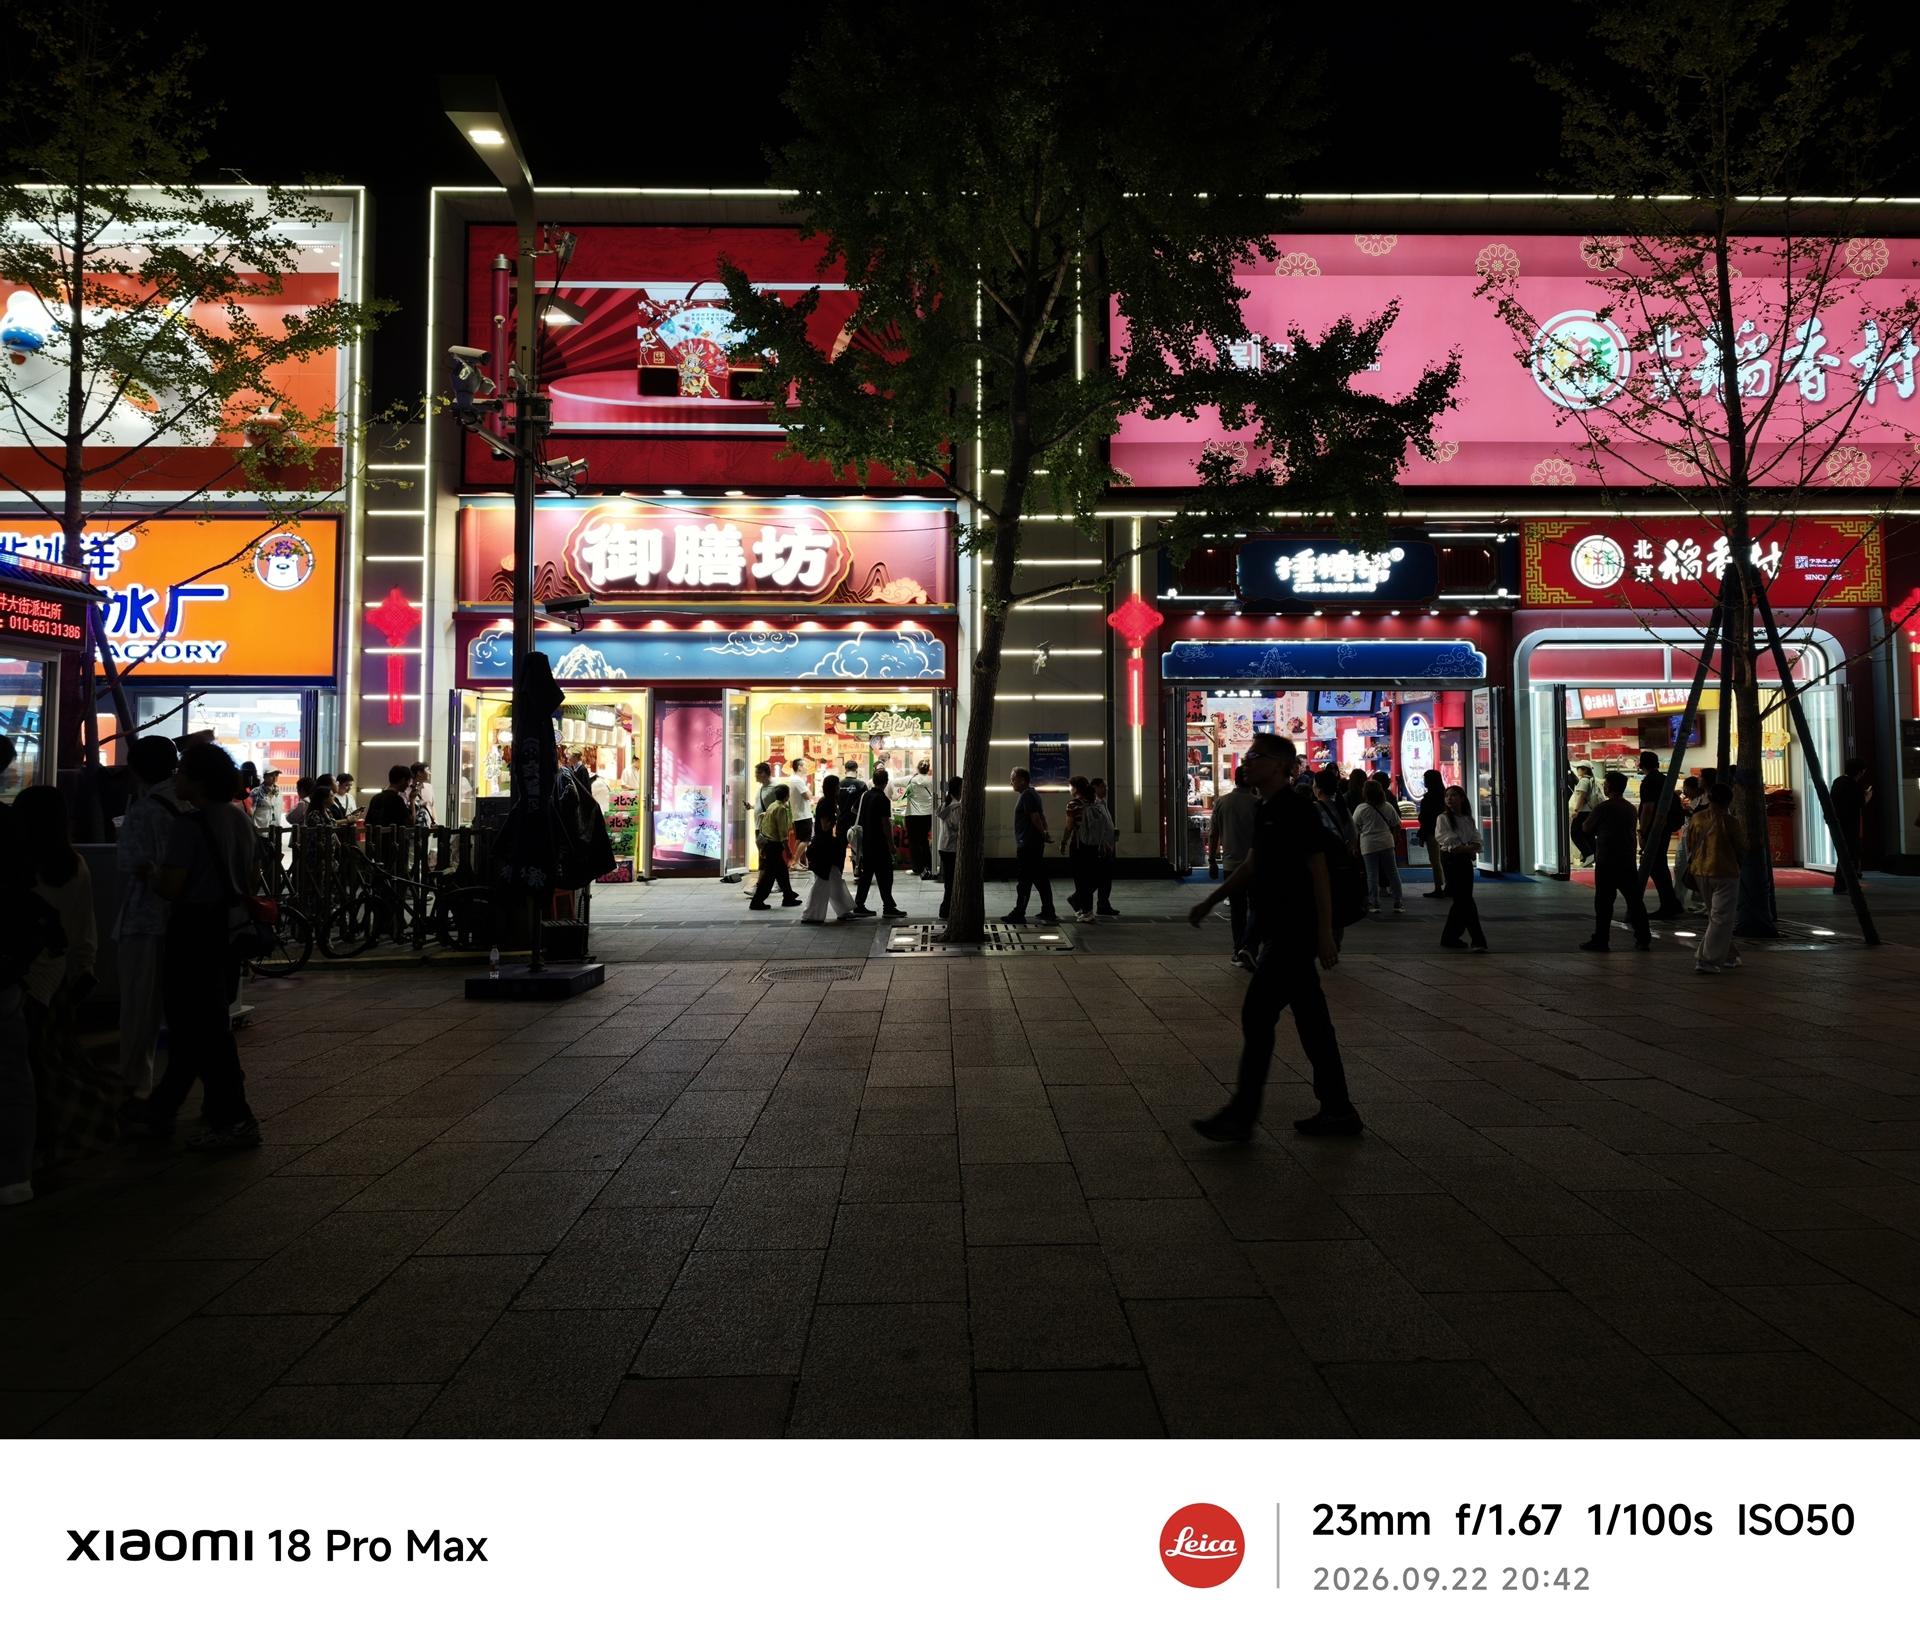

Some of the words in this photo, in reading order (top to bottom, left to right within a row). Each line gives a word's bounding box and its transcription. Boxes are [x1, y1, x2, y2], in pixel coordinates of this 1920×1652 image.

[582, 522, 833, 586] 御膳坊
[1633, 539, 1654, 582] 北京
[9, 615, 81, 640] 010-65131386
[867, 712, 921, 737] 全国包邮
[610, 816, 634, 828] 北京
